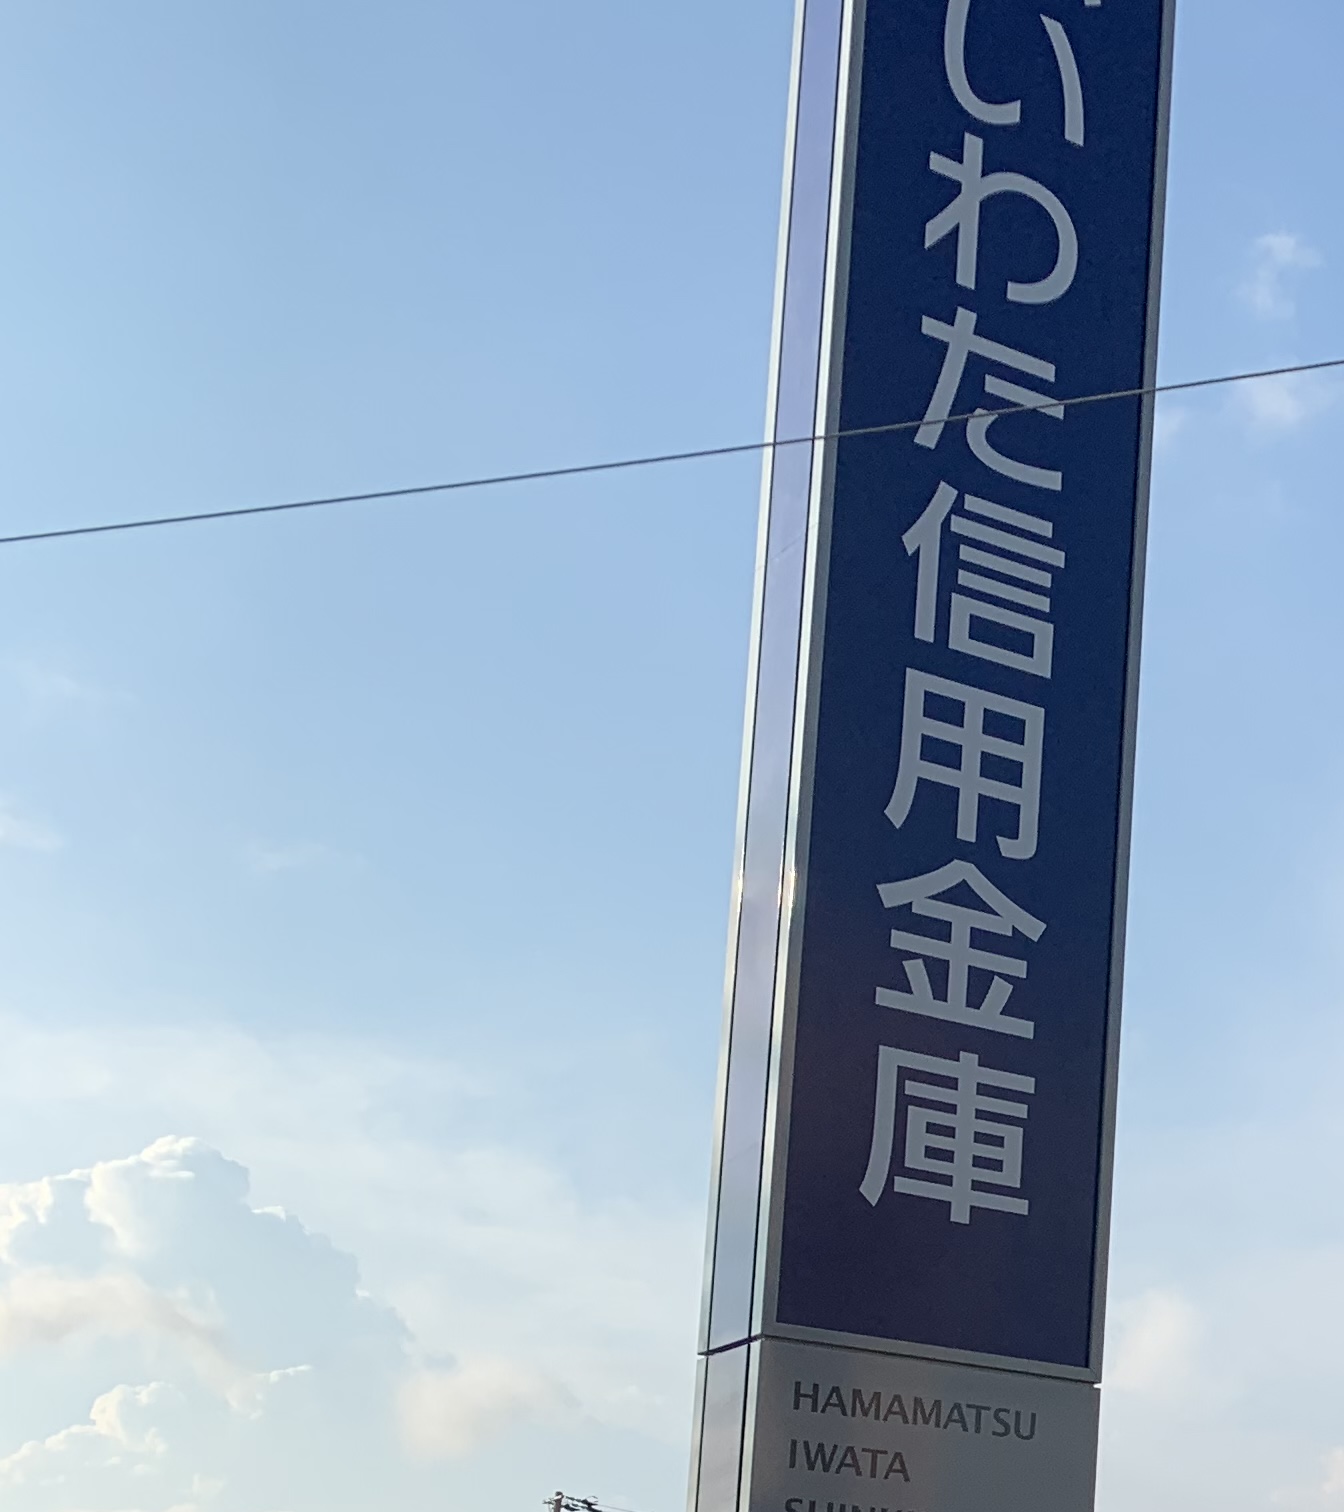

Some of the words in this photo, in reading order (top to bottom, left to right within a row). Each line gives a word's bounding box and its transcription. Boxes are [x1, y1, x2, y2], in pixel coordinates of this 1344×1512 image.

[859, 0, 1100, 1225] いわた信用金庫
[793, 1380, 1037, 1440] HAMAMATSU
[789, 1439, 910, 1483] IWATA
